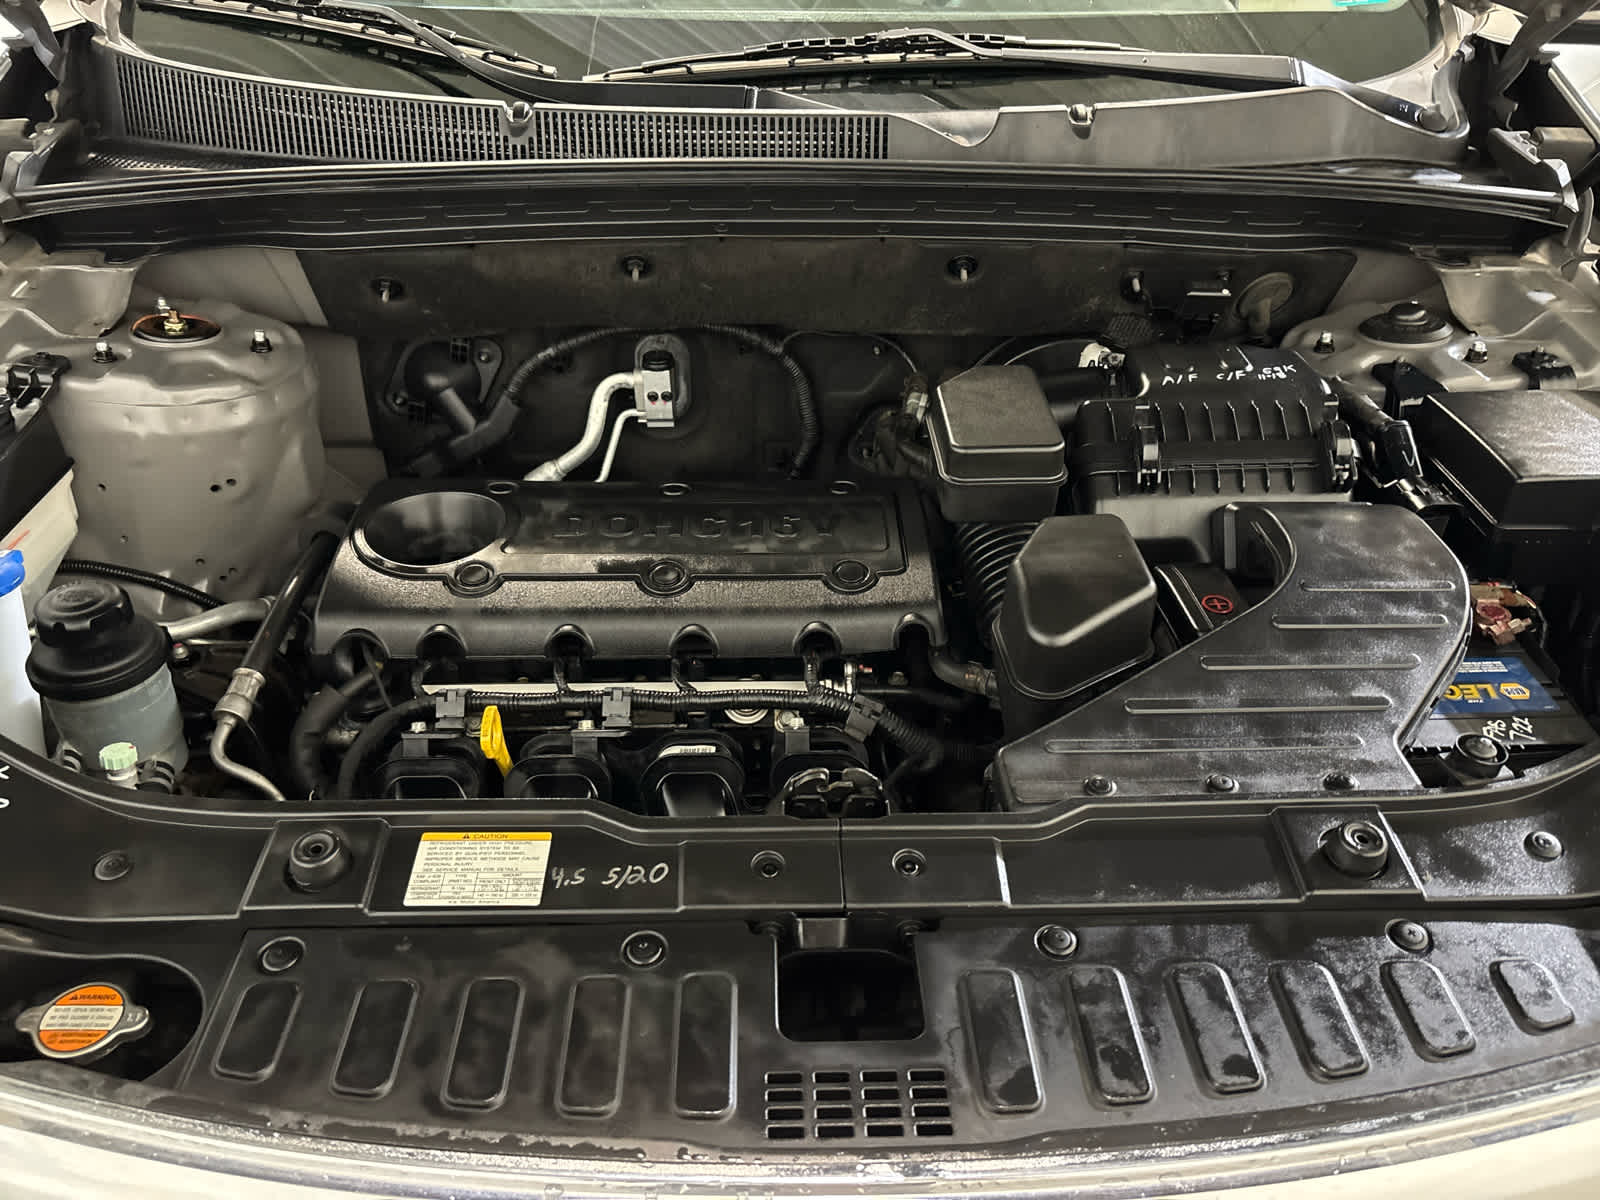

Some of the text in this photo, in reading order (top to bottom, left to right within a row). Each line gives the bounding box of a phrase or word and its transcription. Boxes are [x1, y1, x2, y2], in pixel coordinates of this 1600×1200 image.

[552, 515, 728, 538] DOHC
[1503, 687, 1527, 696] NAPA
[551, 862, 669, 889] 4.5 5/20
